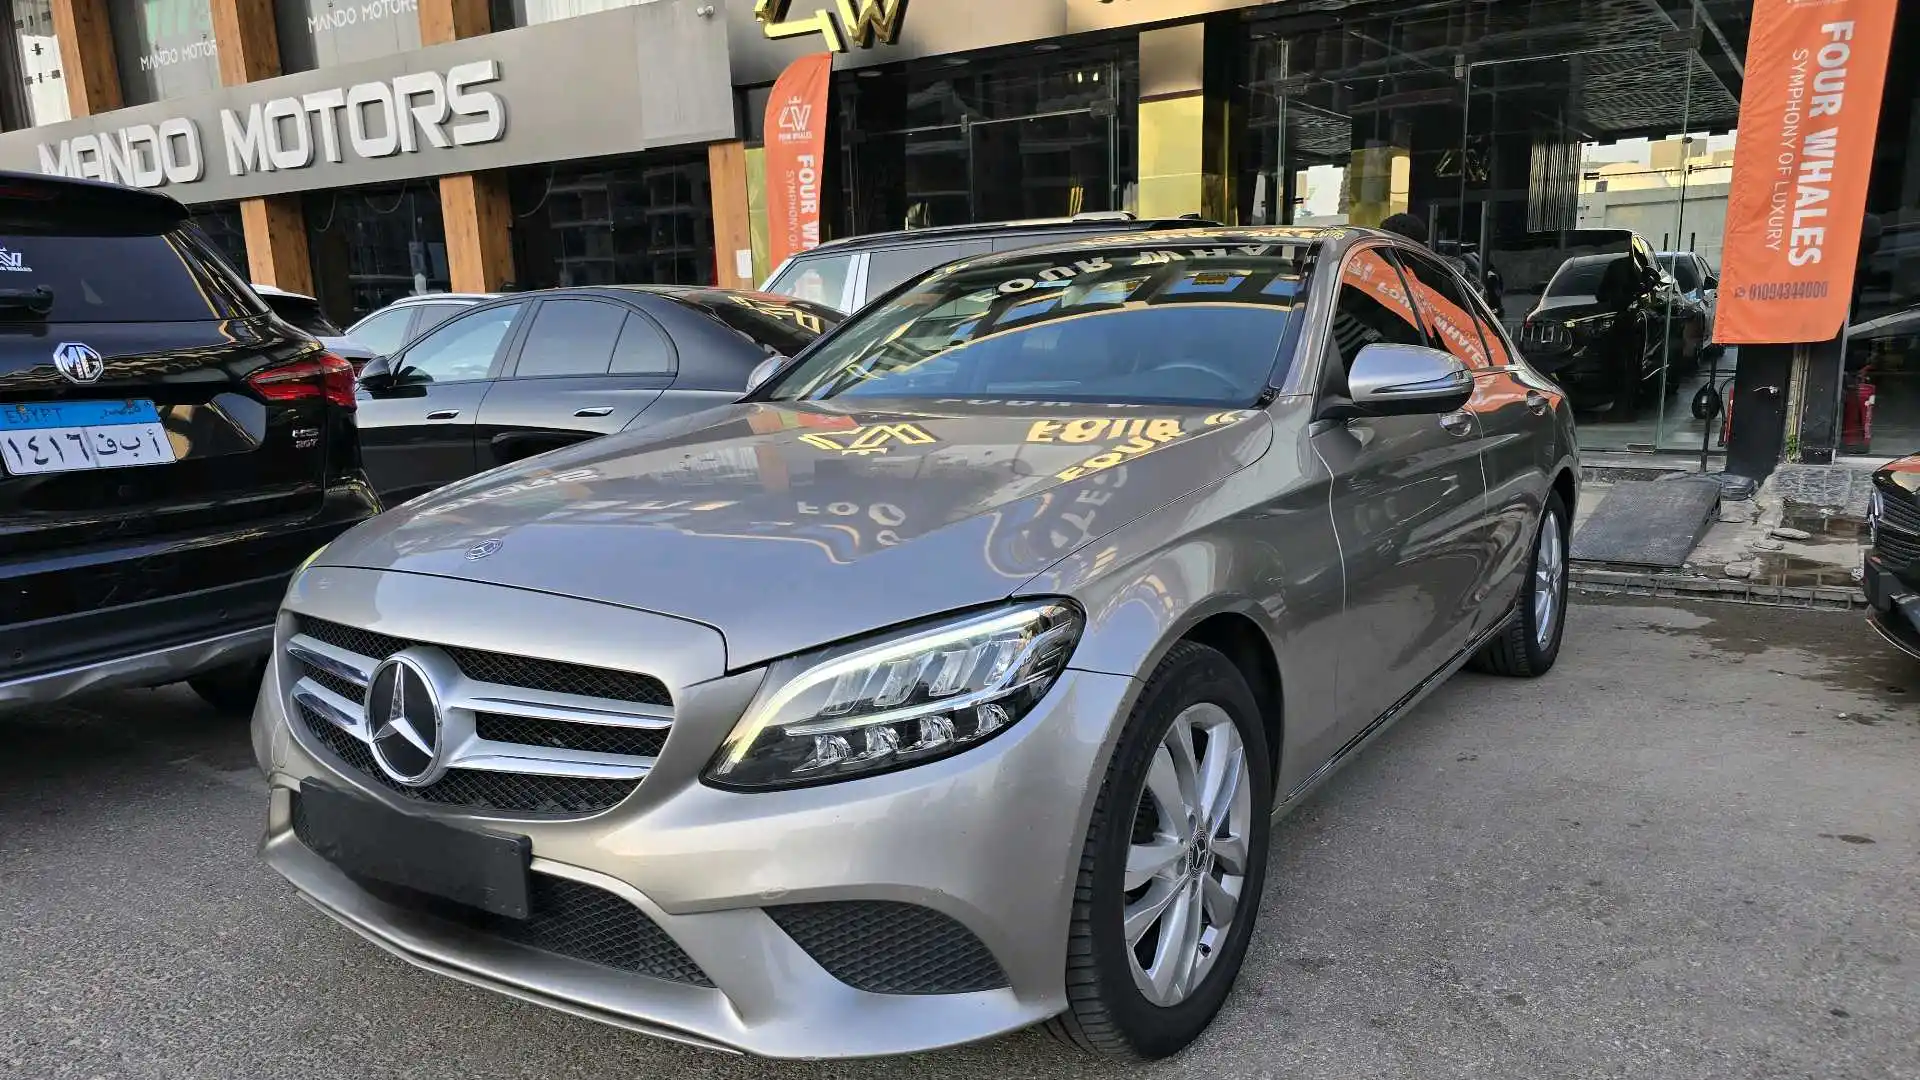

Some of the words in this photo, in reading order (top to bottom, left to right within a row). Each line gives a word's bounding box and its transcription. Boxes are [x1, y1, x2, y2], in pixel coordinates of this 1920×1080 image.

[307, 9, 357, 34] MANDO
[139, 46, 178, 71] MANDO
[181, 39, 217, 62] MOTOR
[1808, 20, 1856, 118] FOUR
[37, 117, 204, 188] MANDO
[220, 60, 507, 178] MOTORS
[1778, 47, 1809, 149] SYMPHONY
[797, 155, 817, 214] FOUR
[1777, 151, 1795, 178] OF
[1788, 127, 1839, 267] WHALES
[1764, 180, 1790, 251] LUXURY
[60, 346, 100, 379] MG
